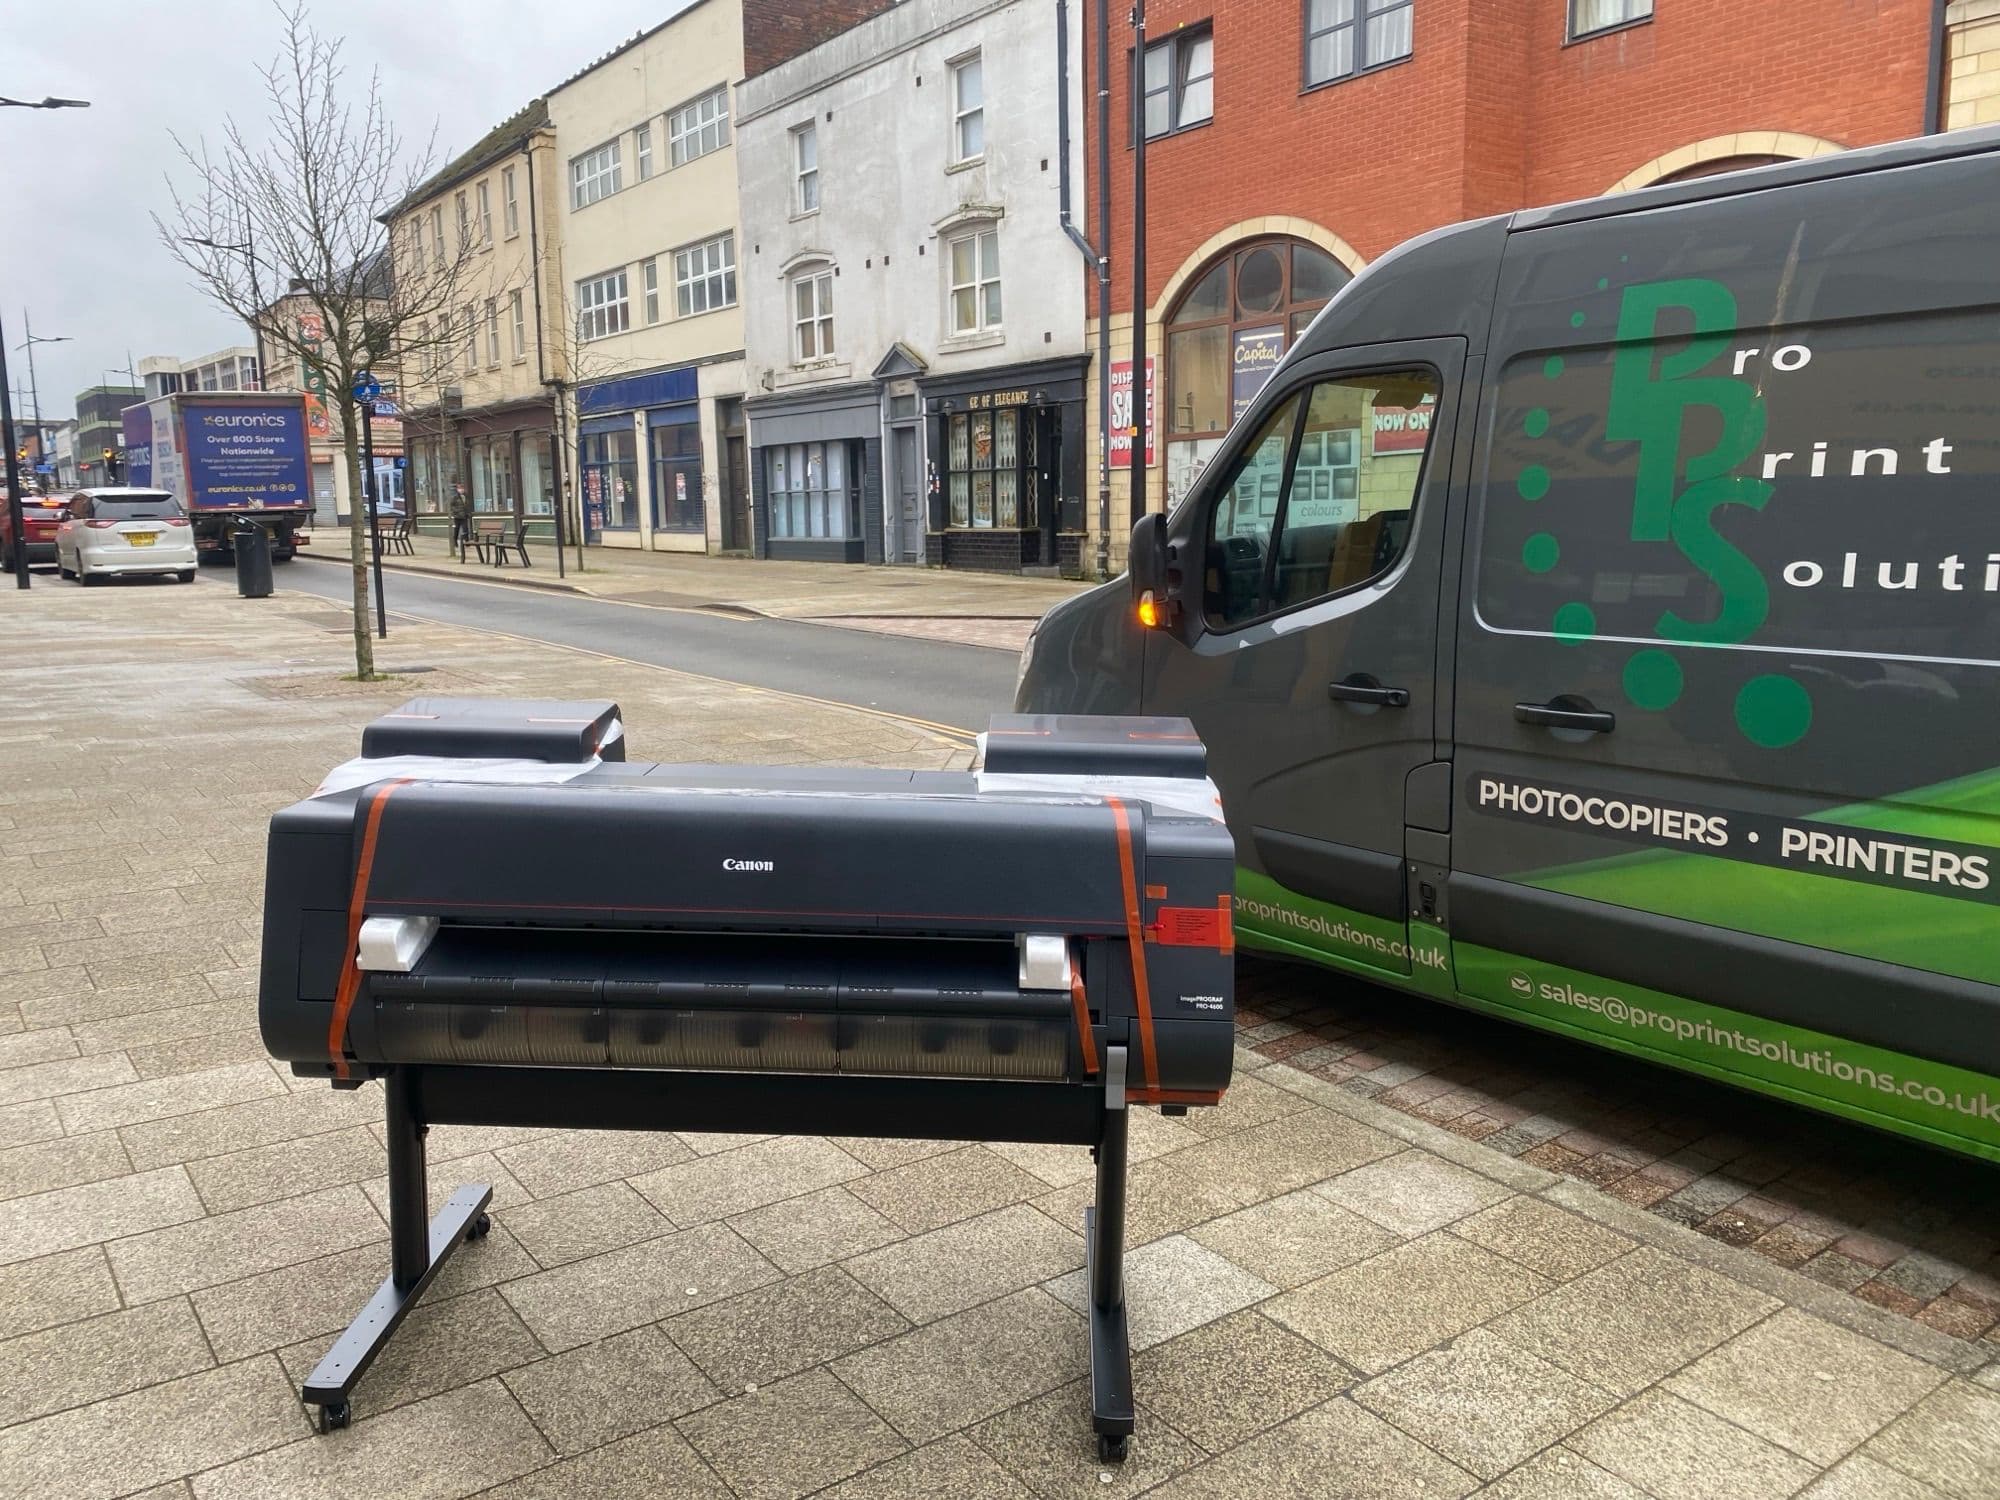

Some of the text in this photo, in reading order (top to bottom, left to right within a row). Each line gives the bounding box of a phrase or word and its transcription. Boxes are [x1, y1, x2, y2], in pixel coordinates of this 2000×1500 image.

[1234, 341, 1283, 364] Capital
[1111, 367, 1153, 385] DISPY
[994, 390, 1029, 407] ELEGANCE
[1111, 388, 1152, 430] SAE
[213, 412, 286, 427] euronics
[1375, 413, 1407, 432] NOW
[207, 435, 231, 444] Over
[255, 435, 286, 443] Stores
[220, 447, 275, 456] Nationwide
[207, 483, 267, 493] euronics.co.uk
[1300, 502, 1343, 518] colours
[1479, 779, 1990, 890] PHOTOCOPIERS PRINTERS
[722, 858, 774, 871] Canon
[1539, 983, 2000, 1124] sales@proprintsolutions.co.uk
